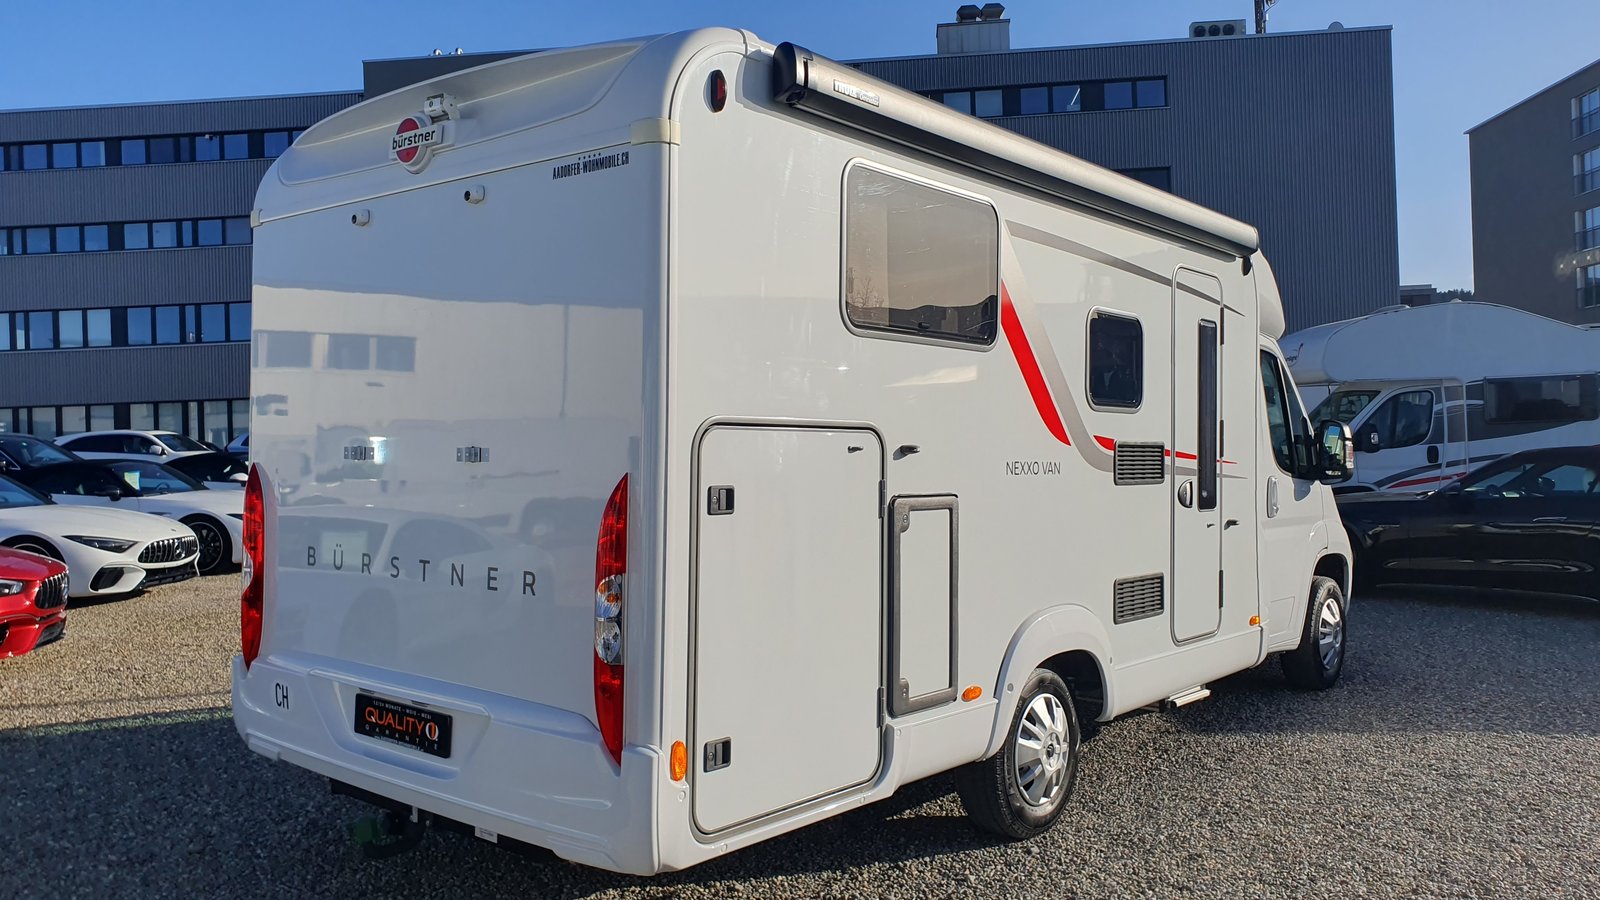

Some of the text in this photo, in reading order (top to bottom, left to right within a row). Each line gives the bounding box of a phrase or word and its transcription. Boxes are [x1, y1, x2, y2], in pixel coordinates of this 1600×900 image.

[392, 129, 436, 151] bürstner
[1005, 461, 1061, 476] NEXXO VAN
[307, 543, 537, 597] BÜRSTNER
[275, 682, 290, 710] CH
[365, 706, 425, 736] QUALITY
[365, 723, 439, 751] GARANTIE
